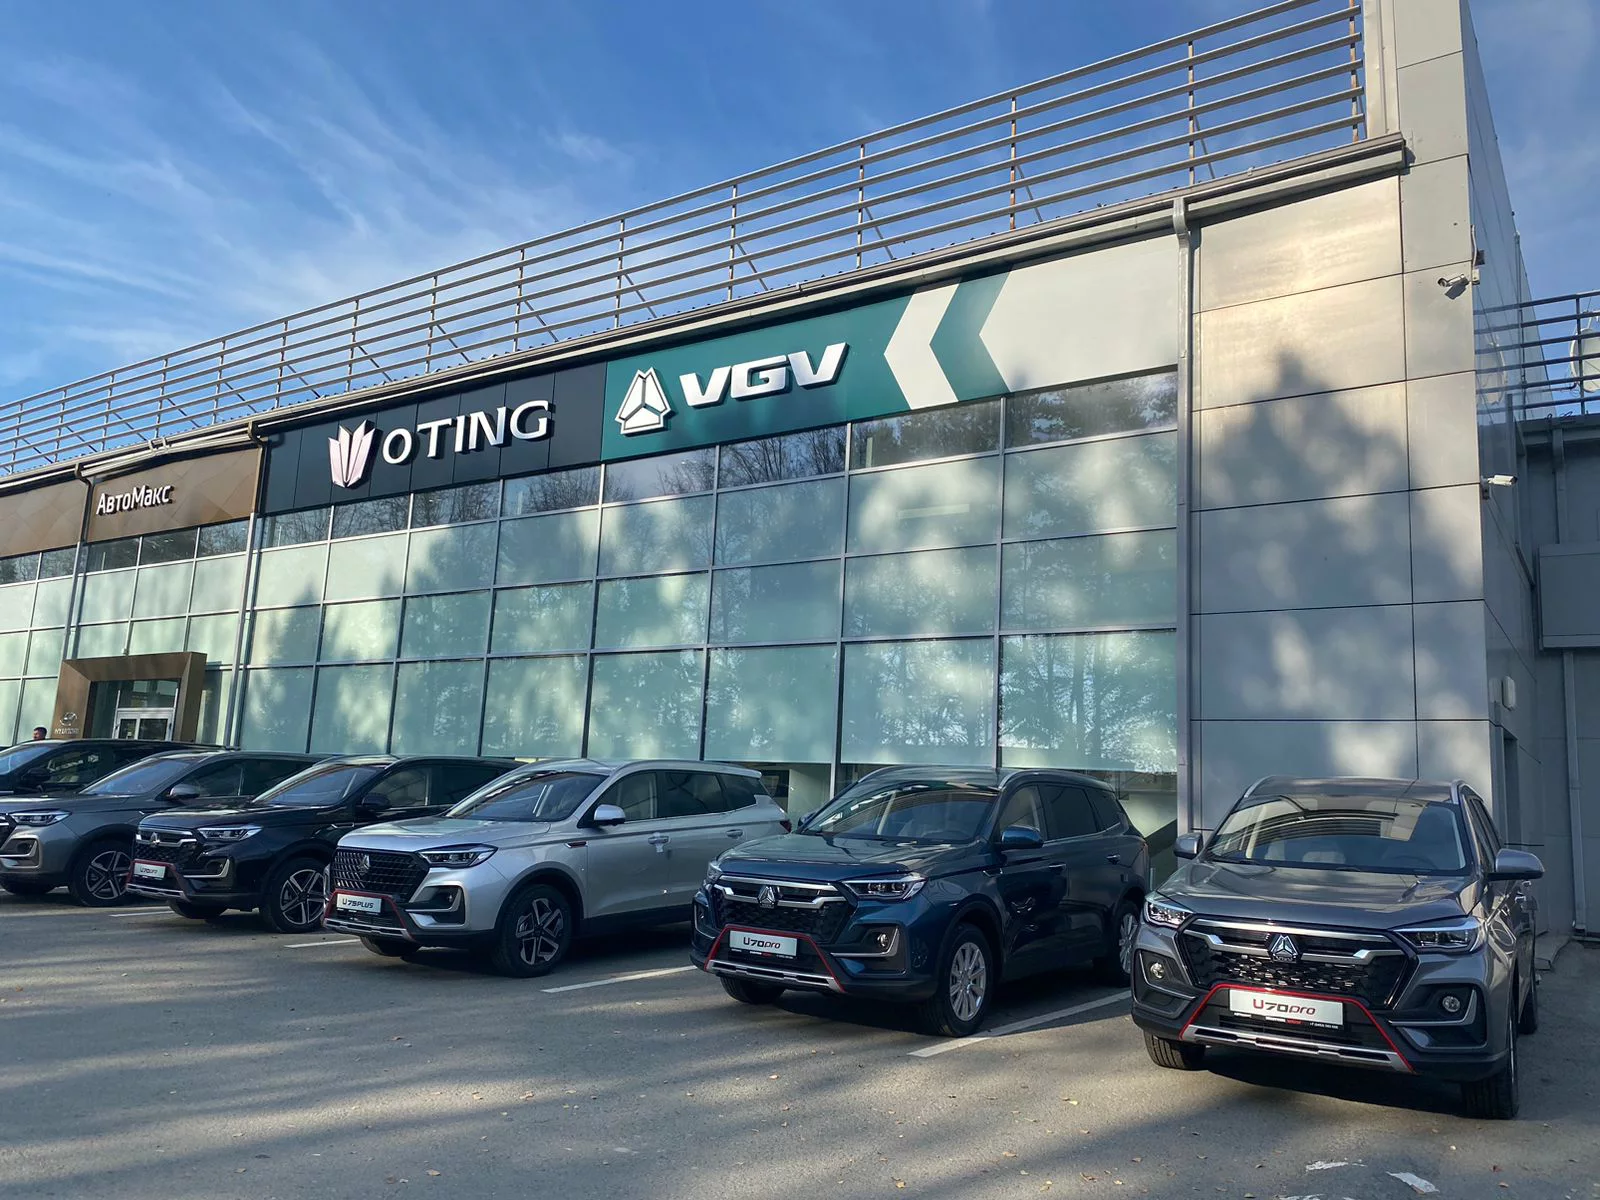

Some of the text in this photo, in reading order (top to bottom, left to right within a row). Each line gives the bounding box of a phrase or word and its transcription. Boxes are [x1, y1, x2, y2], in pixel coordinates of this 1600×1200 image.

[679, 342, 847, 406] VGV
[95, 485, 171, 515] АвтоМакс
[1253, 998, 1316, 1015] U70pro
